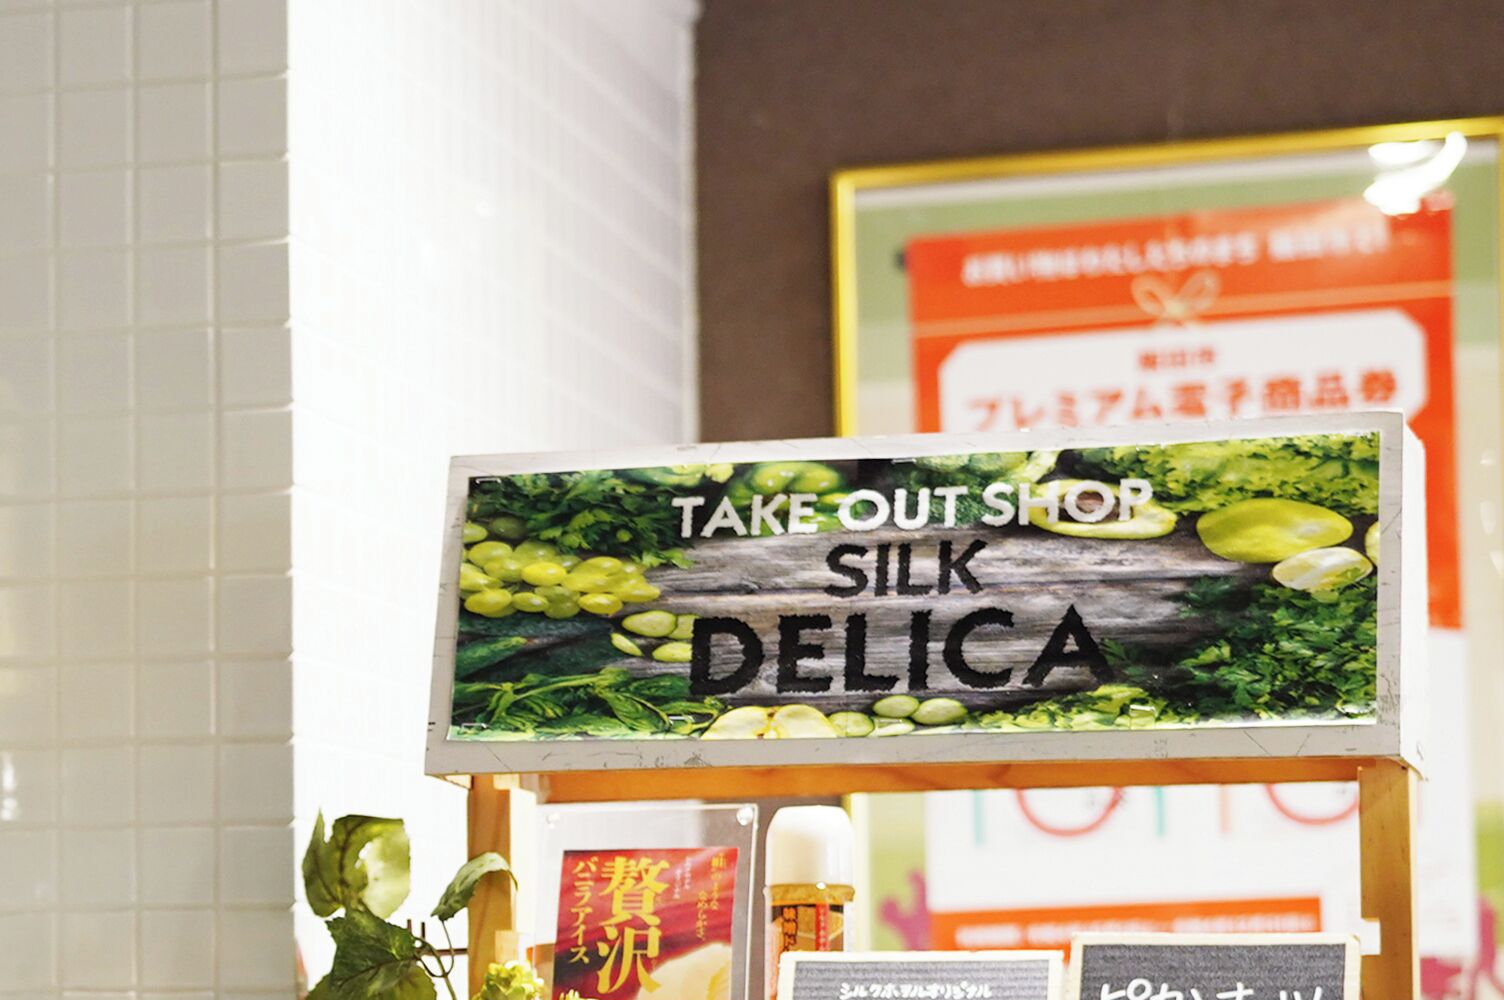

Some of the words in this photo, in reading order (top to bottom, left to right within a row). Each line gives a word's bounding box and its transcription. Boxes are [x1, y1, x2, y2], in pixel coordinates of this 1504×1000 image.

[671, 493, 819, 539] TAKE
[836, 486, 969, 532] OUT
[981, 478, 1154, 527] SHOP
[825, 538, 989, 598] SILK
[689, 603, 1113, 697] DELICA
[569, 856, 599, 965] バニラアイス
[597, 855, 671, 995] 贅沢
